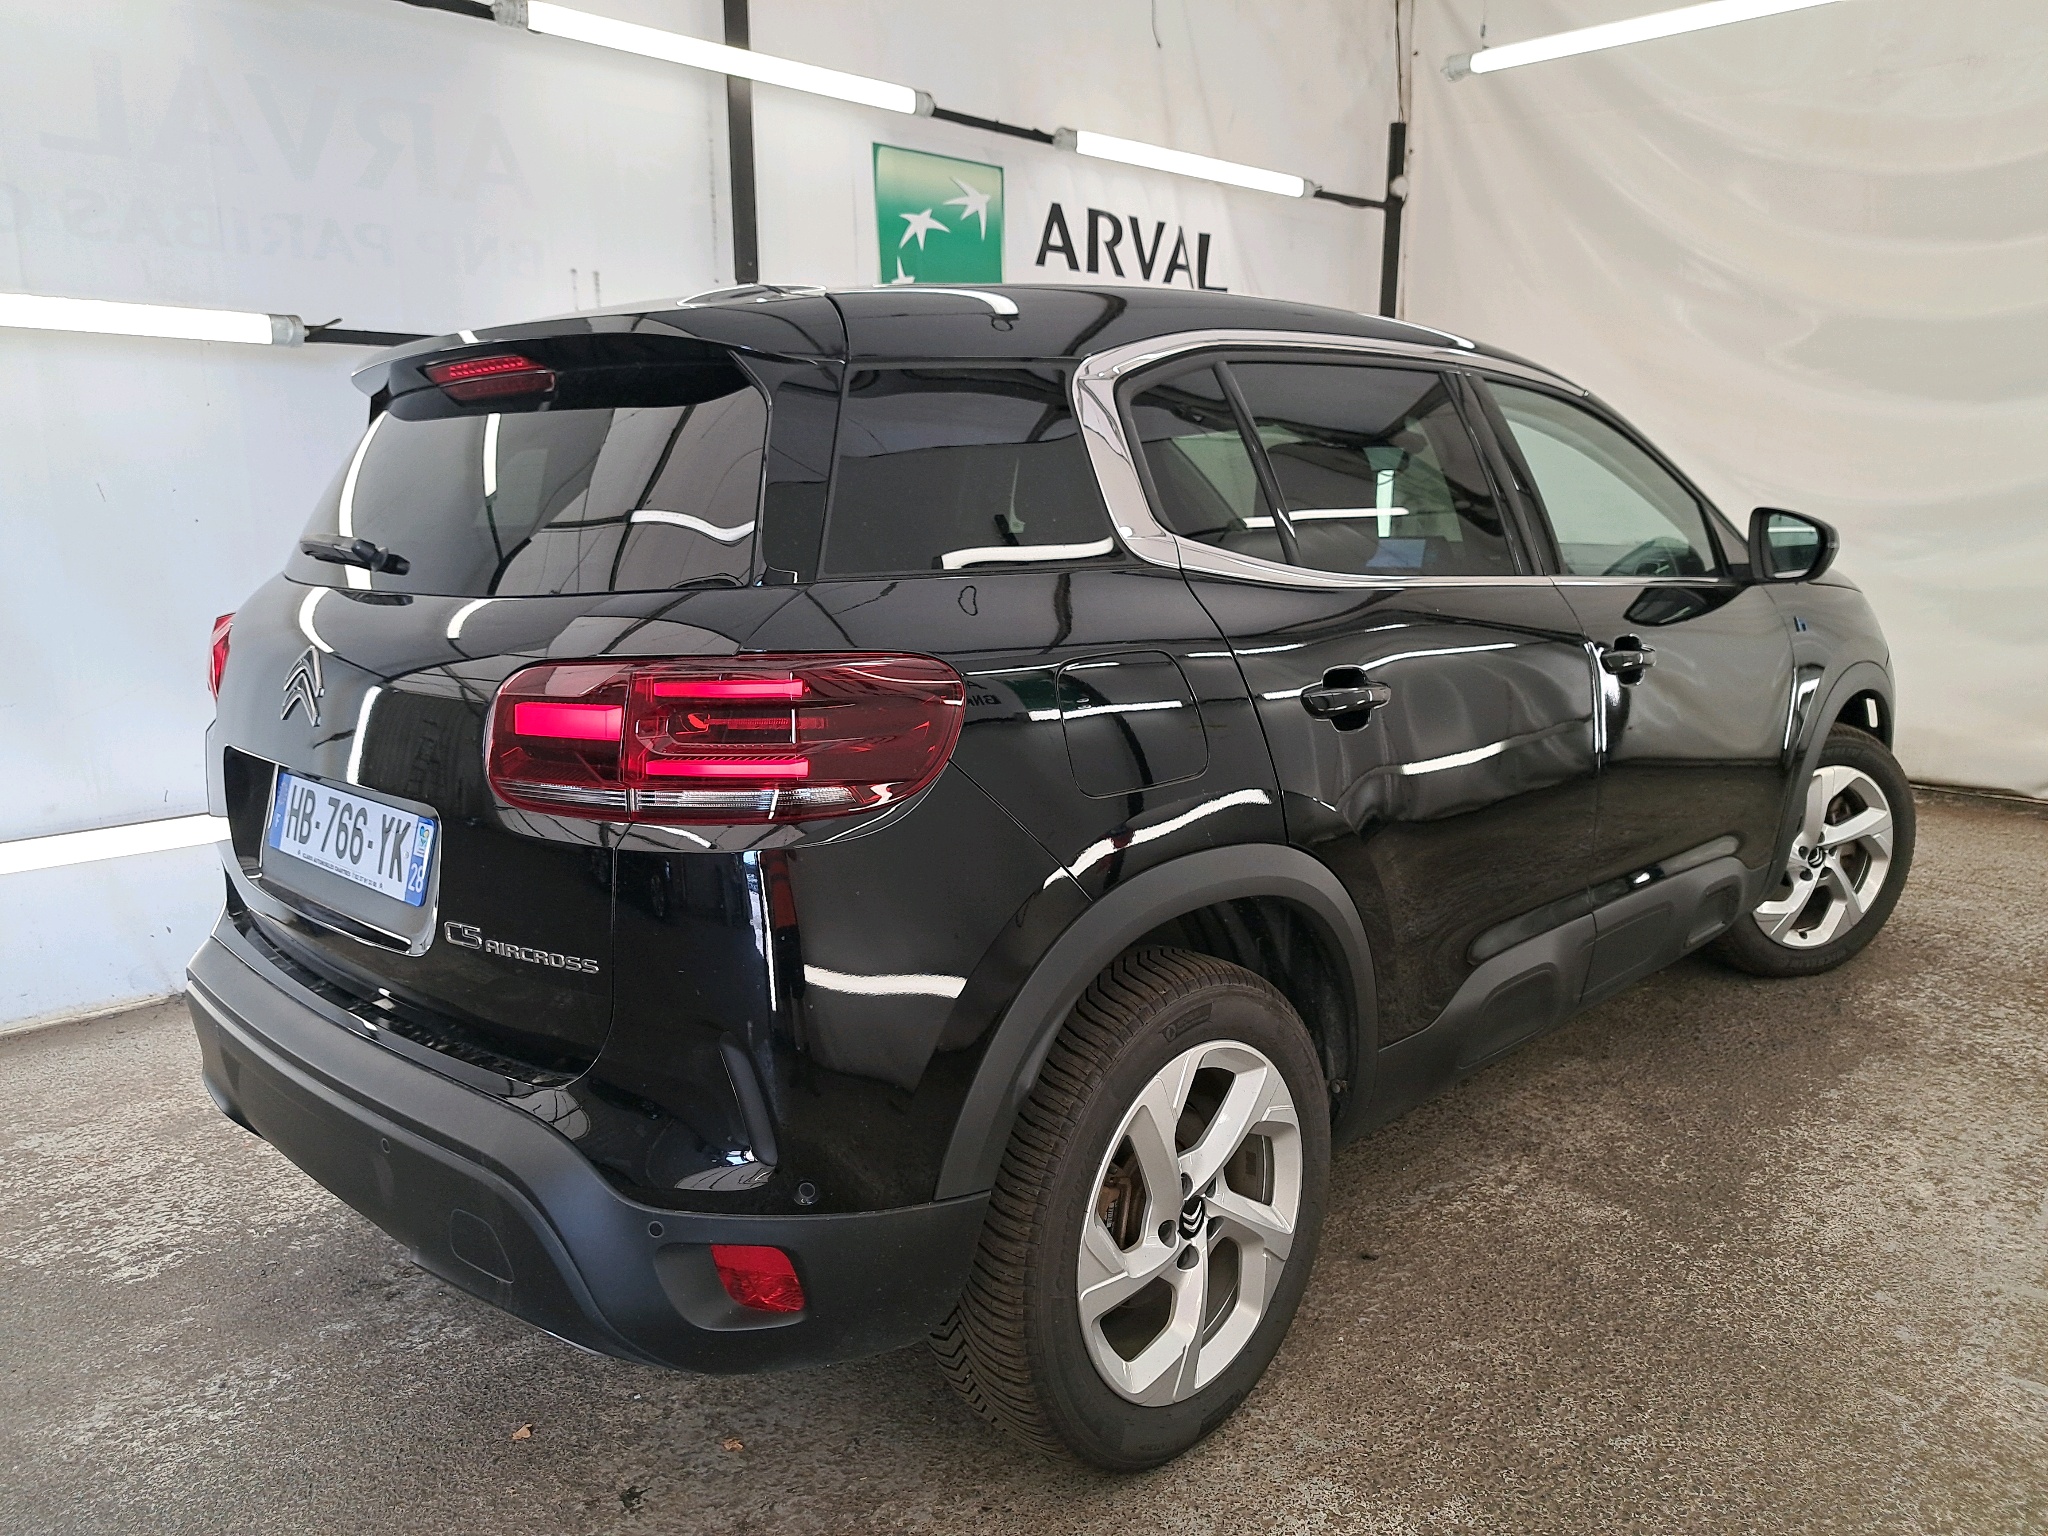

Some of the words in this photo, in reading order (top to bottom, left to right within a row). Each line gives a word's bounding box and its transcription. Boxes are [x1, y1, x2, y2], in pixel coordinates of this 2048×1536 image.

[1035, 202, 1228, 292] ARVAL
[286, 785, 411, 882] HB-766-YK
[407, 863, 424, 893] 28
[443, 920, 483, 950] C5
[485, 939, 600, 974] AIRCROSS
